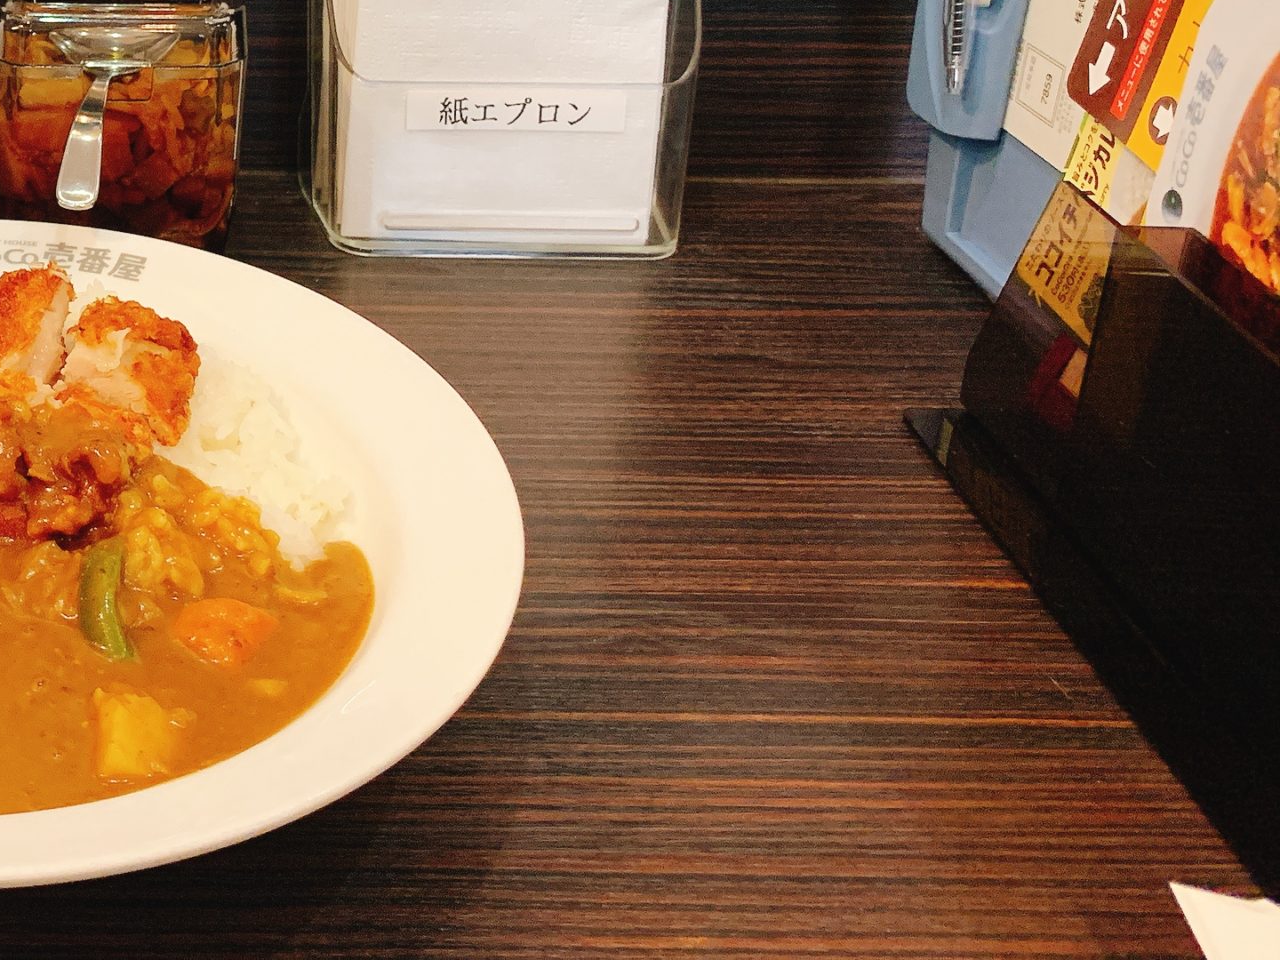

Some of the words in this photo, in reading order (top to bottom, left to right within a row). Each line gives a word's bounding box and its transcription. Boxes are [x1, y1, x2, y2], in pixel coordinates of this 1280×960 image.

[438, 96, 592, 125] 紙エプロン
